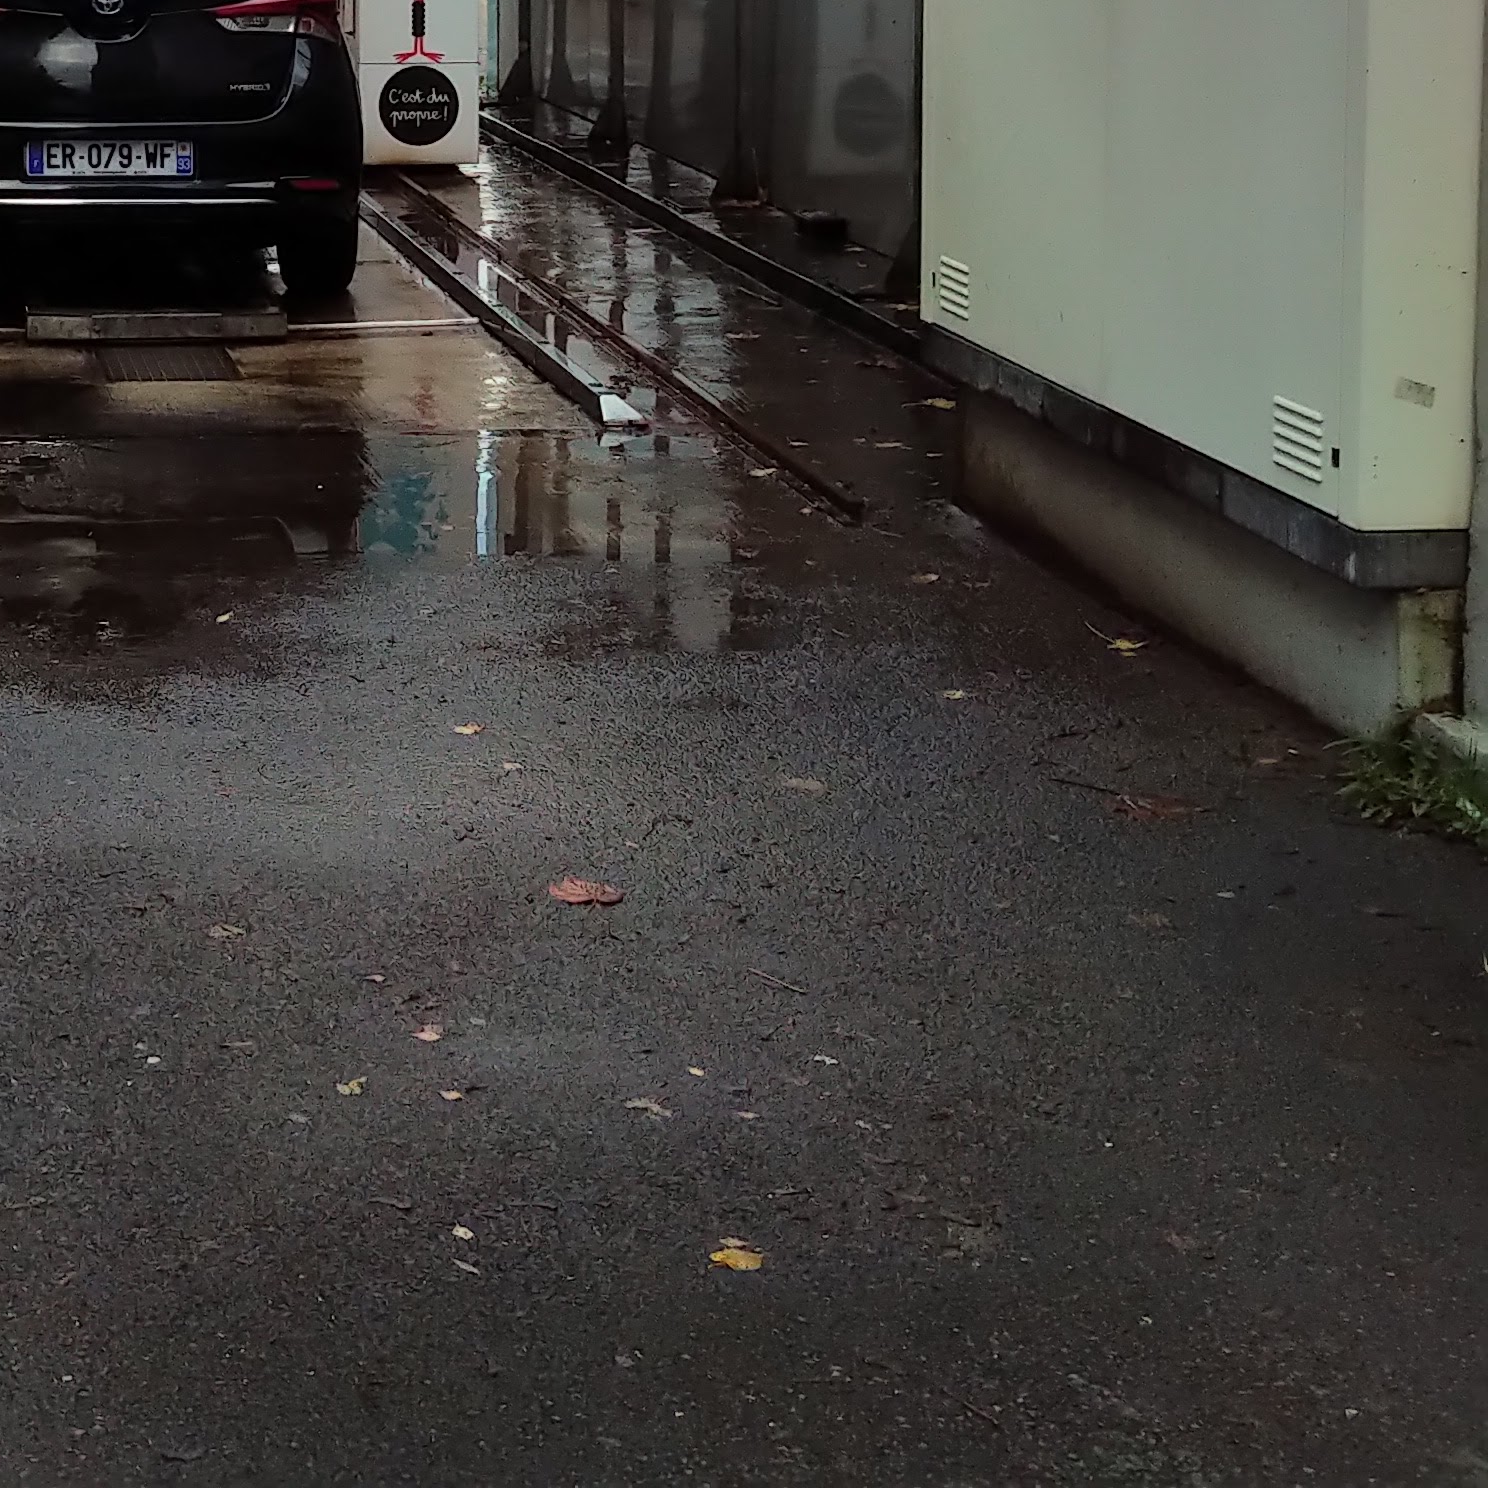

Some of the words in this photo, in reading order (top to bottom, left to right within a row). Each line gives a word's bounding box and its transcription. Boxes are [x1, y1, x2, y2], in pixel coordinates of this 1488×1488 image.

[388, 88, 425, 105] C'est
[426, 87, 451, 104] du
[46, 142, 174, 169] ER-079-WF
[177, 158, 191, 171] 93
